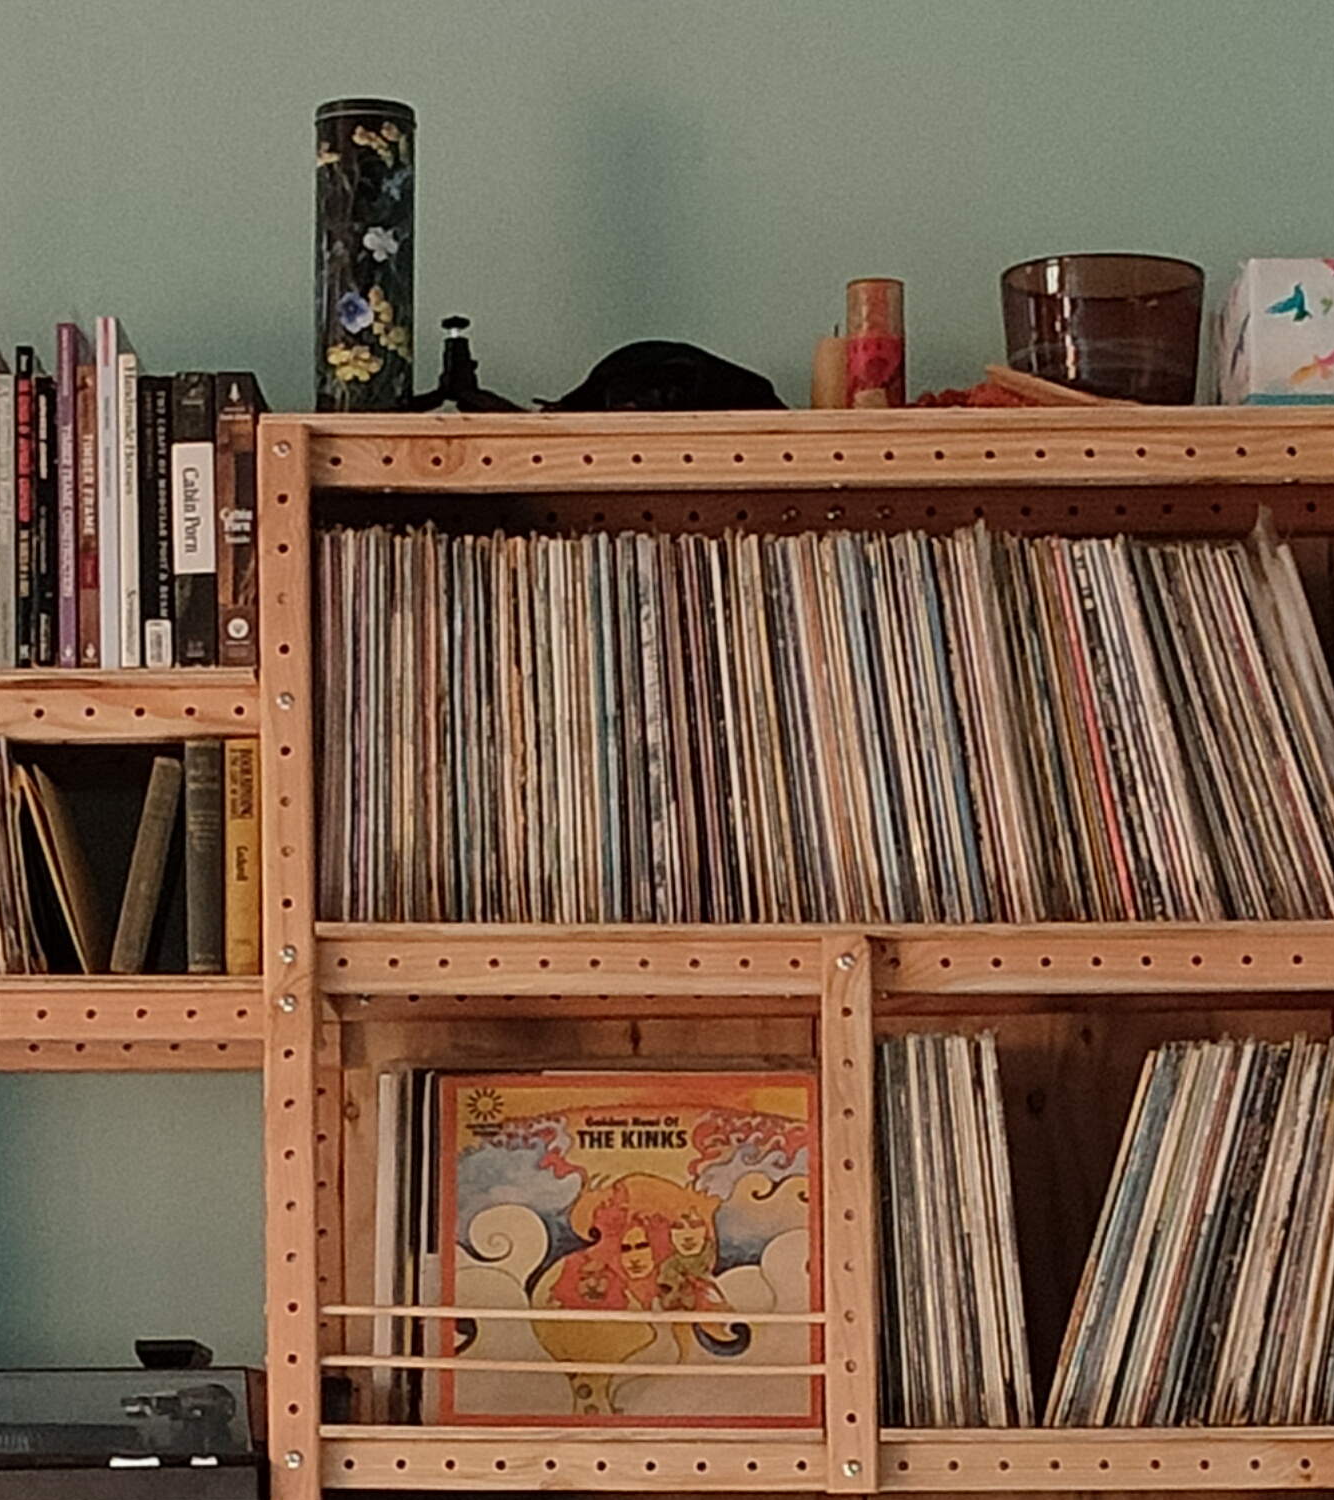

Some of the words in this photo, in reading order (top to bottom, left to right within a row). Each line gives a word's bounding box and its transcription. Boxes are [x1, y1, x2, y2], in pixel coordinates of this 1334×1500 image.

[81, 433, 95, 485] TIMBER
[81, 488, 95, 536] FRAME
[181, 467, 200, 513] Cabin
[183, 517, 201, 553] Porn
[577, 1129, 616, 1150] THE
[621, 1129, 688, 1150] KINKS
